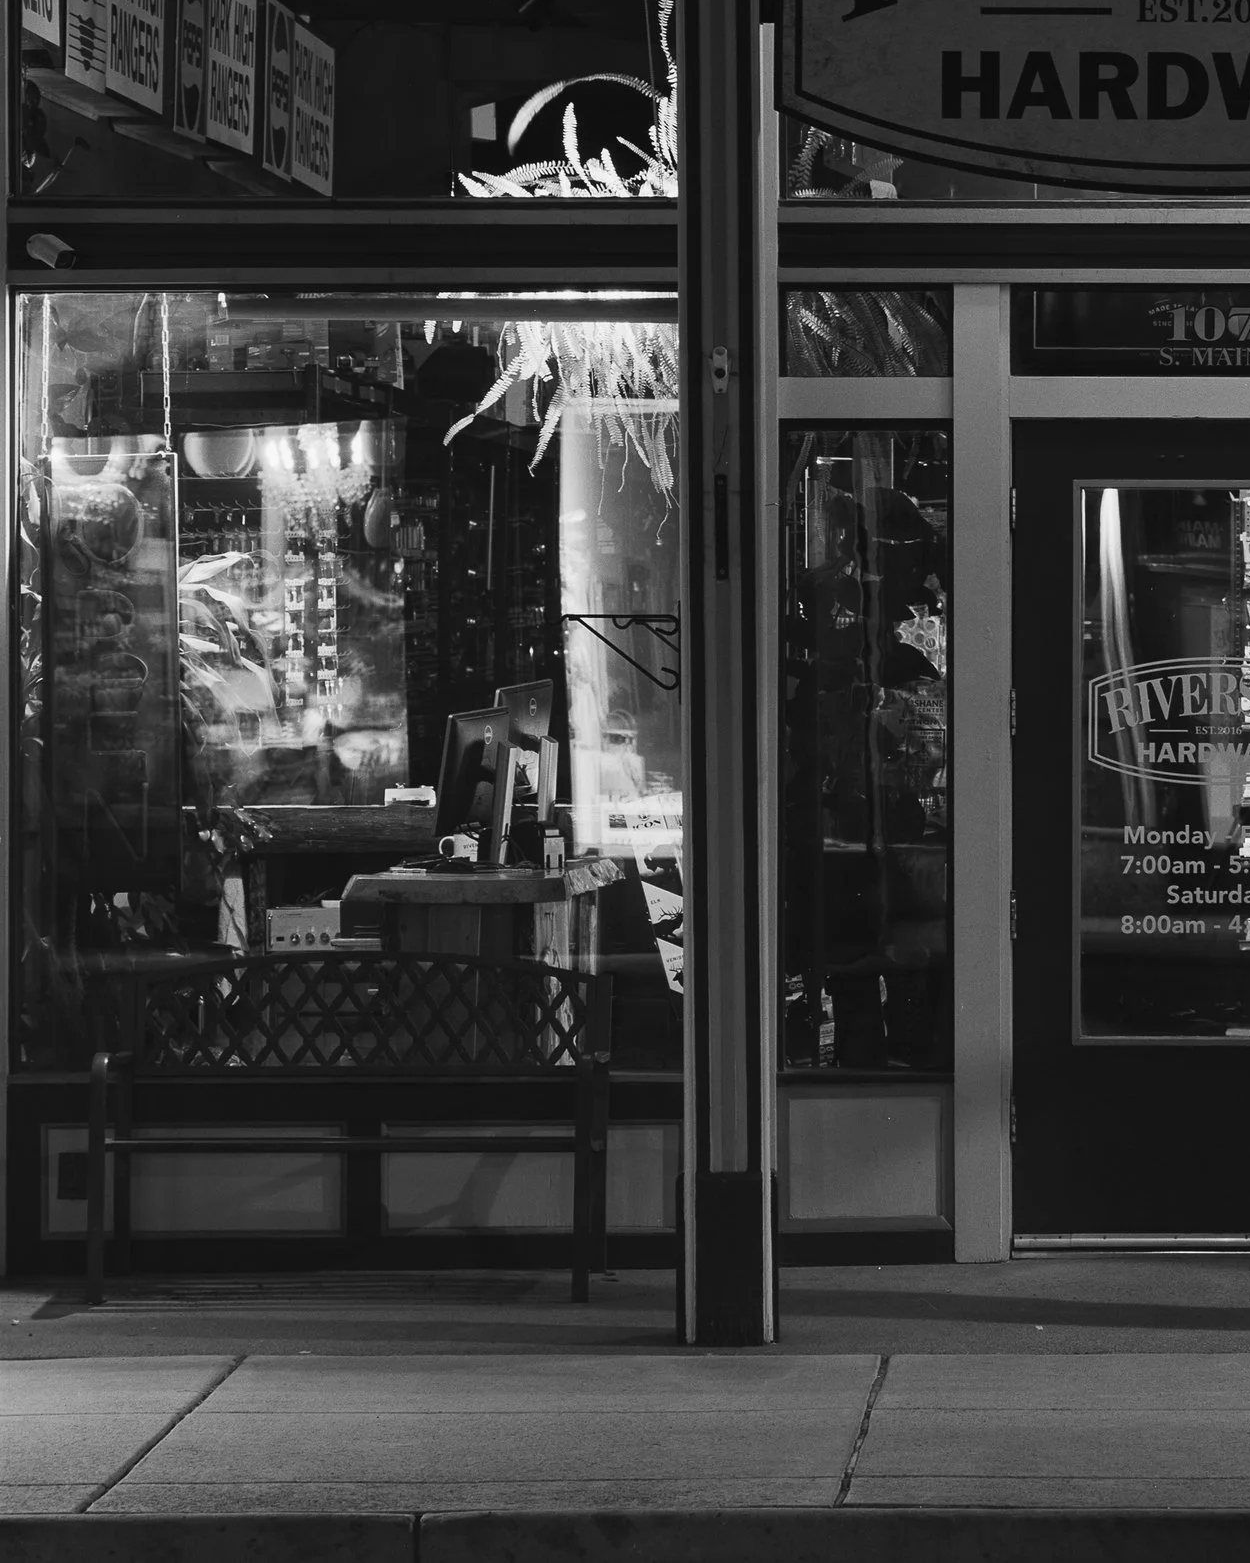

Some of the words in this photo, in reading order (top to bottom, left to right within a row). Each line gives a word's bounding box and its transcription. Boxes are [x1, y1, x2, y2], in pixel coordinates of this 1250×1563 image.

[110, 3, 160, 94] RANGERS
[234, 1, 255, 68] HIGH
[210, 59, 250, 137] RANGERS
[294, 39, 315, 101] PARK
[316, 54, 335, 119] HIGH
[294, 106, 330, 182] RANGERS
[1159, 346, 1181, 367] S.
[1120, 855, 1206, 875] 7:00am
[1123, 825, 1218, 850] Monday
[1120, 915, 1206, 935] 8:00am
